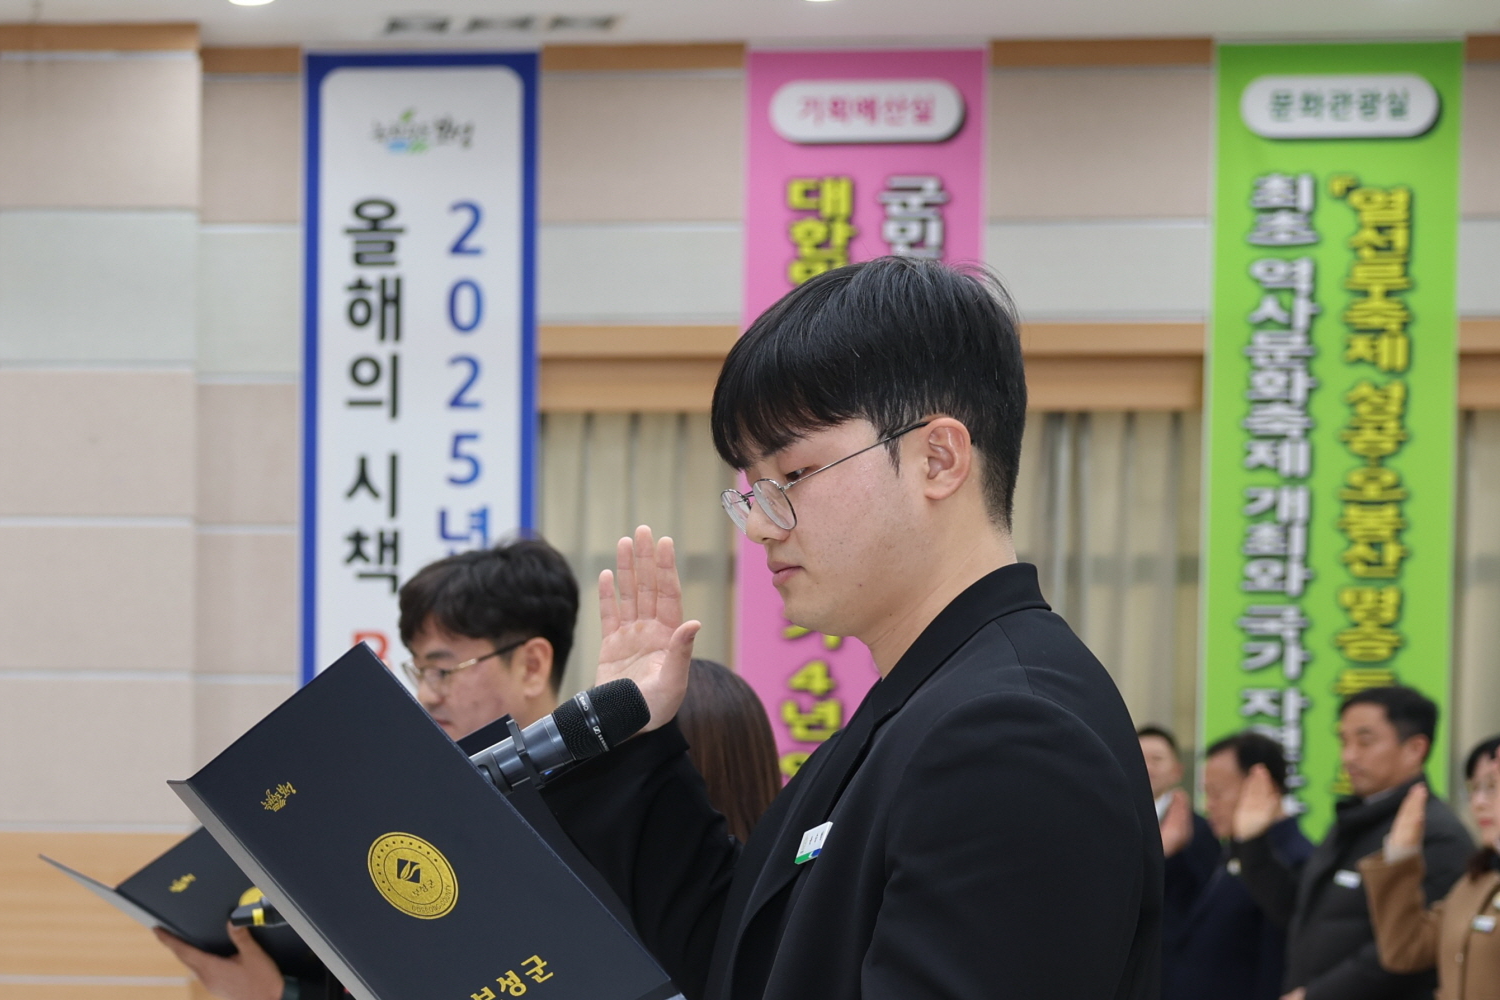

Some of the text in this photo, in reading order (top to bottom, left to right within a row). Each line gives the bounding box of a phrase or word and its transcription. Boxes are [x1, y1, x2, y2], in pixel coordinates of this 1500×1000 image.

[1245, 171, 1320, 247] 최초
[343, 198, 406, 420] 올해의
[1241, 256, 1321, 478] 역사문화축제
[343, 452, 400, 595] 시책
[1237, 604, 1309, 681] 국가
[411, 879, 435, 897] 보성군
